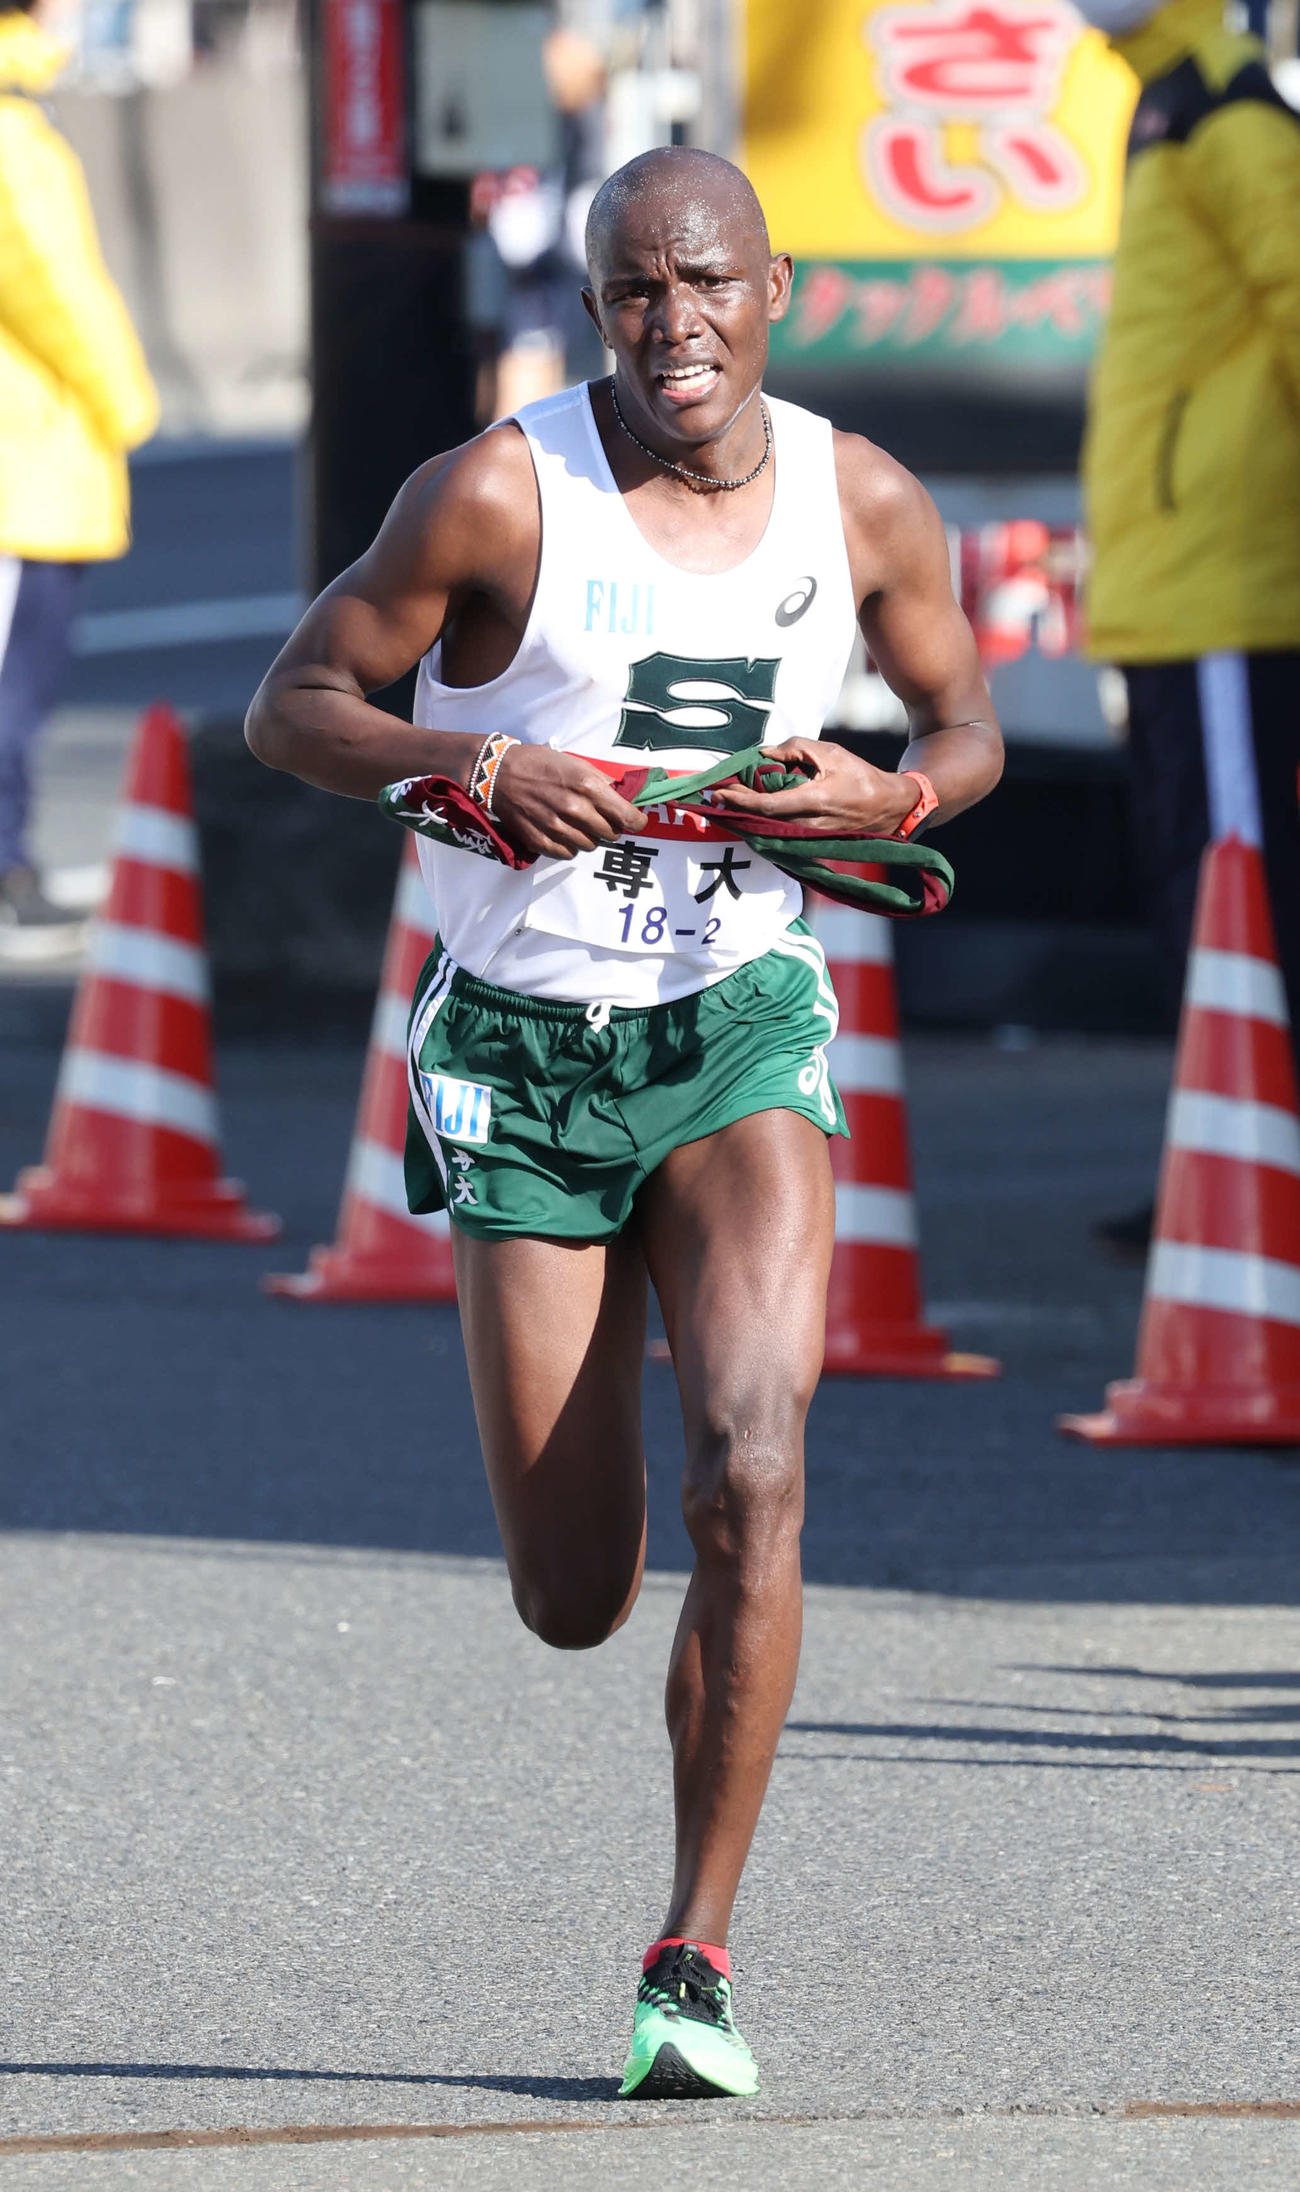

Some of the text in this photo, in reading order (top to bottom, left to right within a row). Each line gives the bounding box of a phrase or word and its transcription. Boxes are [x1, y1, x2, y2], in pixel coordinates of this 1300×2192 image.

[583, 579, 656, 636] FIJI
[612, 651, 783, 756] S
[618, 903, 722, 945] 18-2
